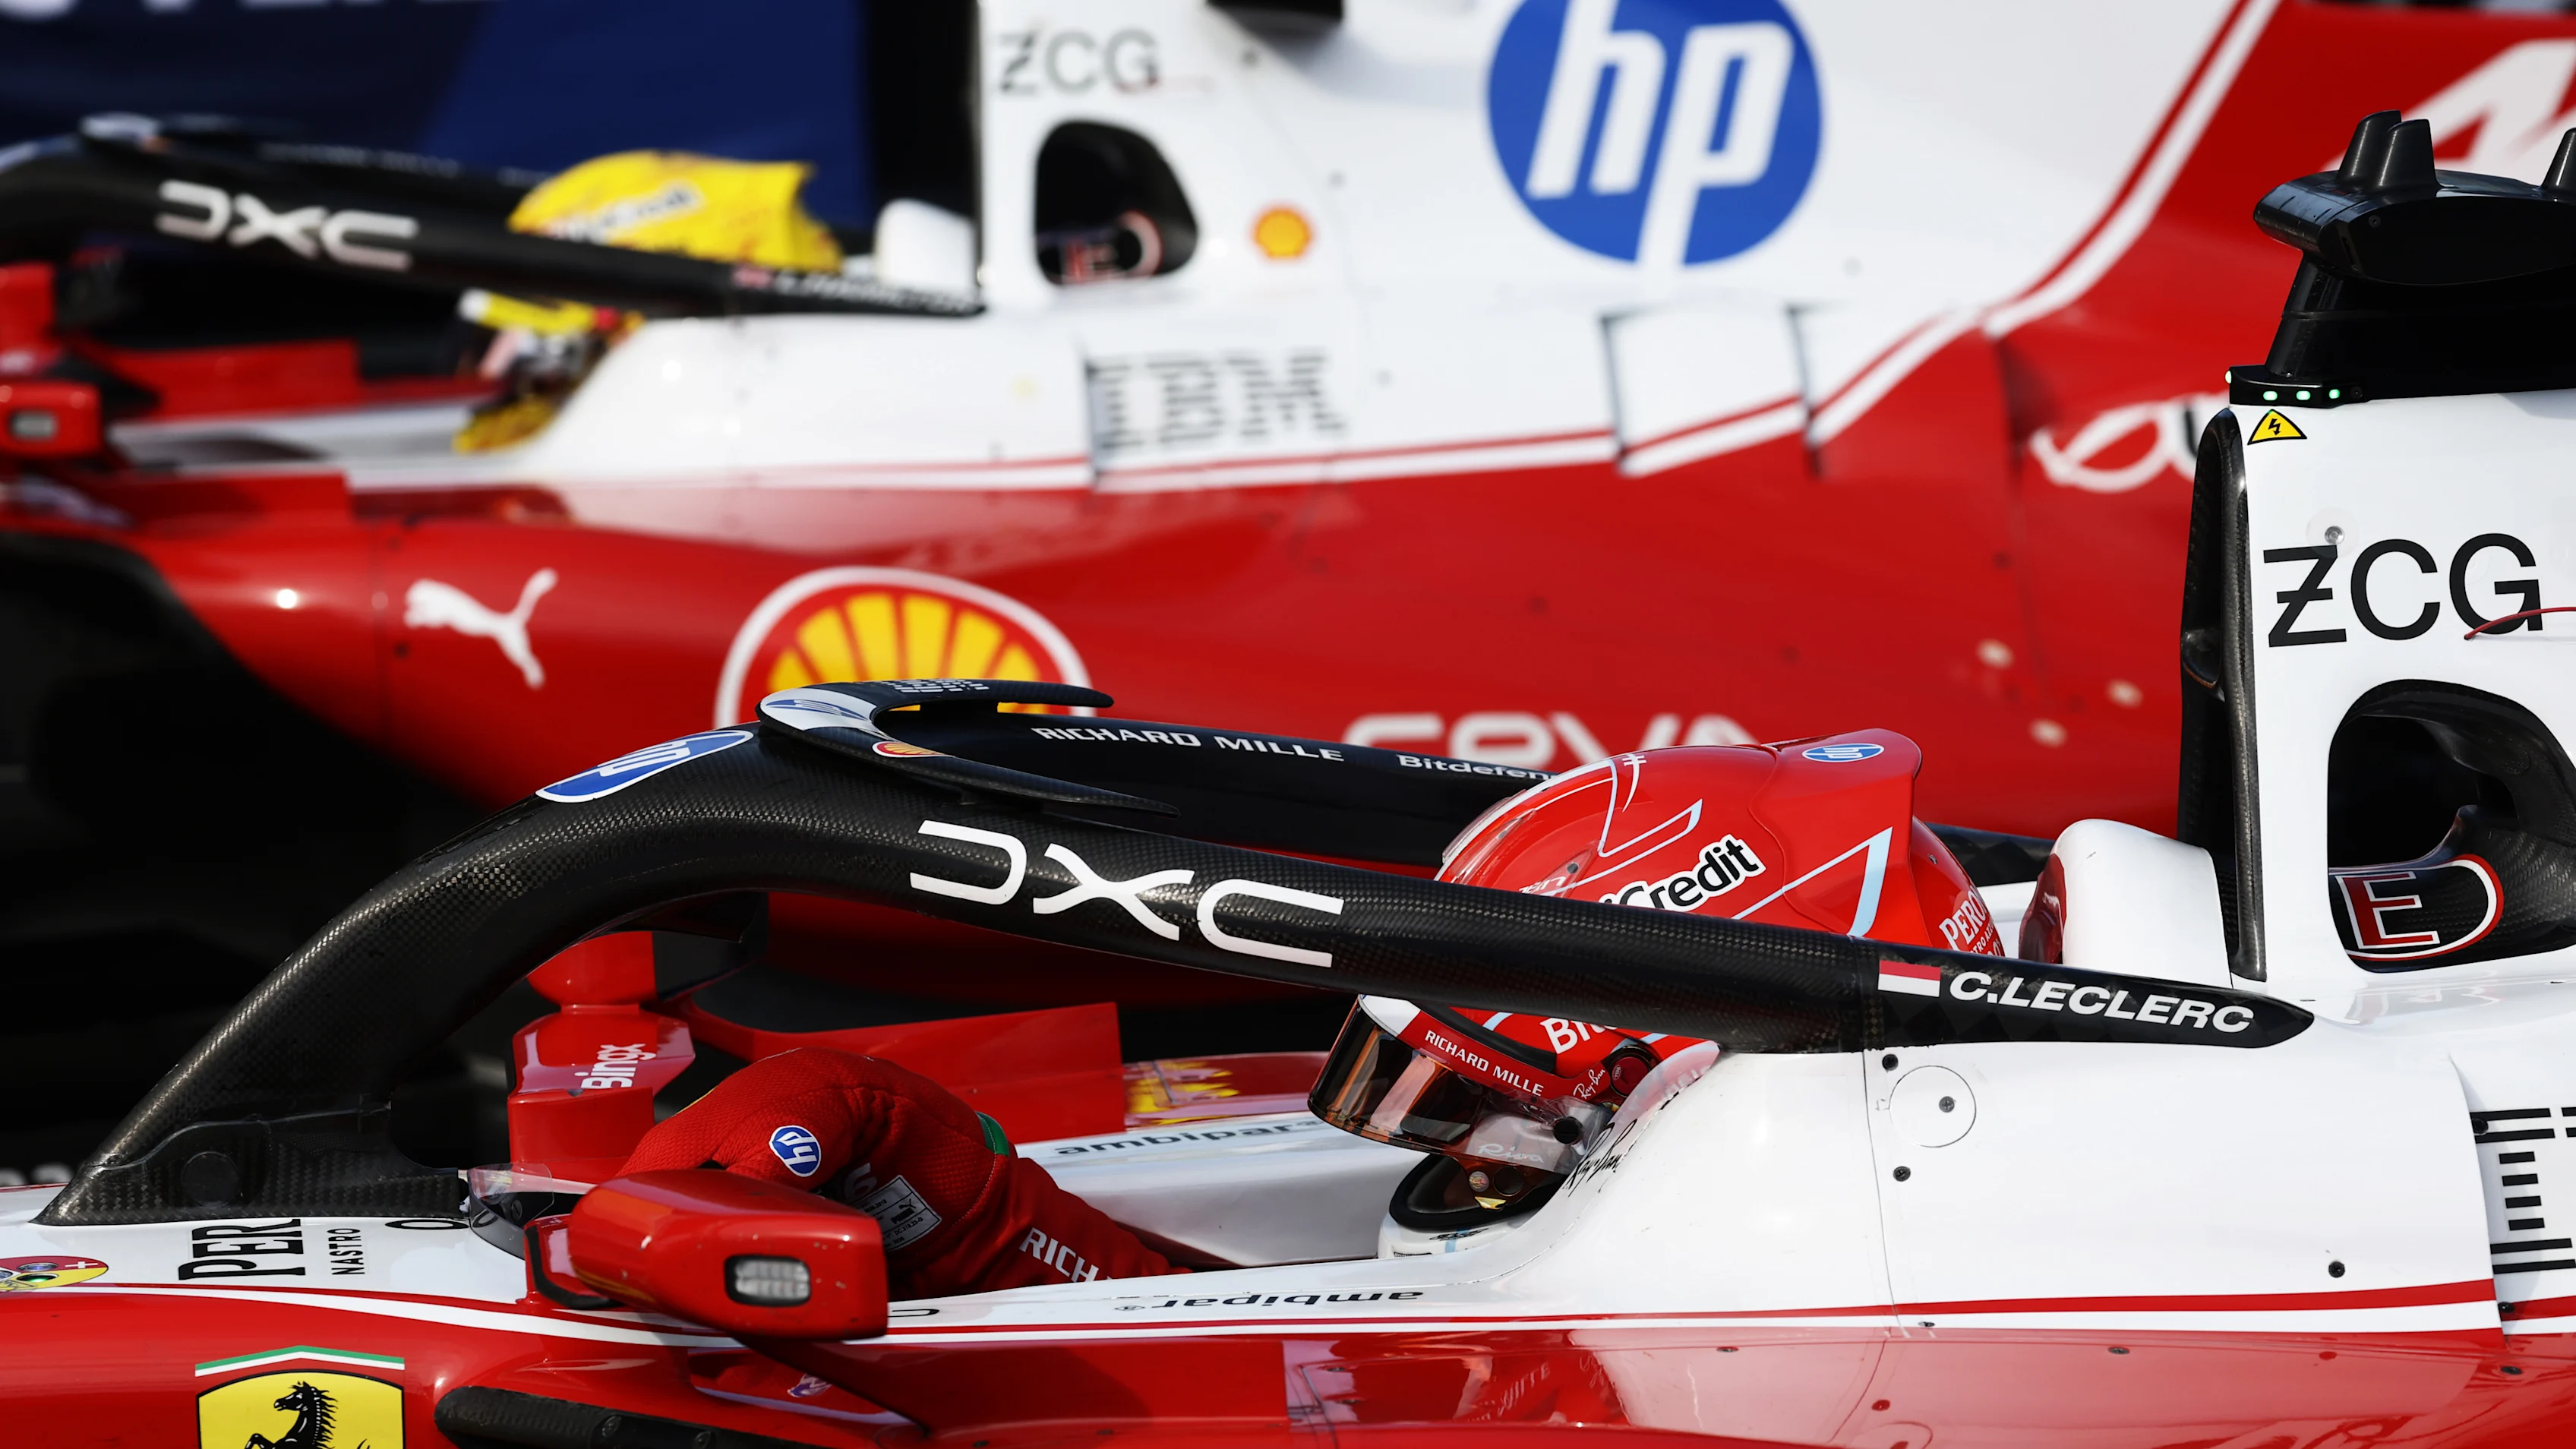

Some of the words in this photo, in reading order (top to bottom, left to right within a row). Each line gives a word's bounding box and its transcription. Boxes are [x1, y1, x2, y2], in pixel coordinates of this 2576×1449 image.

[1525, 0, 1797, 266] hp
[155, 179, 419, 271] DXC
[1091, 348, 1346, 453] IBM
[2263, 533, 2543, 648] ZCG
[1031, 727, 1201, 747] RICHARD
[1214, 735, 1345, 762] MILLE
[1396, 754, 1558, 781] Bitdefen
[910, 819, 1345, 968] DXC
[1602, 839, 1760, 911] Credit
[1939, 884, 1988, 952] PERO
[2334, 871, 2440, 949] E
[1949, 971, 2253, 1034] C.LECLERC
[1425, 1030, 1489, 1072] RICHARD
[1492, 1065, 1544, 1097] MILLE
[1054, 1123, 1293, 1155] ambipar
[178, 1219, 306, 1280] PER
[327, 1228, 365, 1275] NASTRO
[1019, 1227, 1100, 1282] RICH
[1151, 1291, 1423, 1309] ambipar
